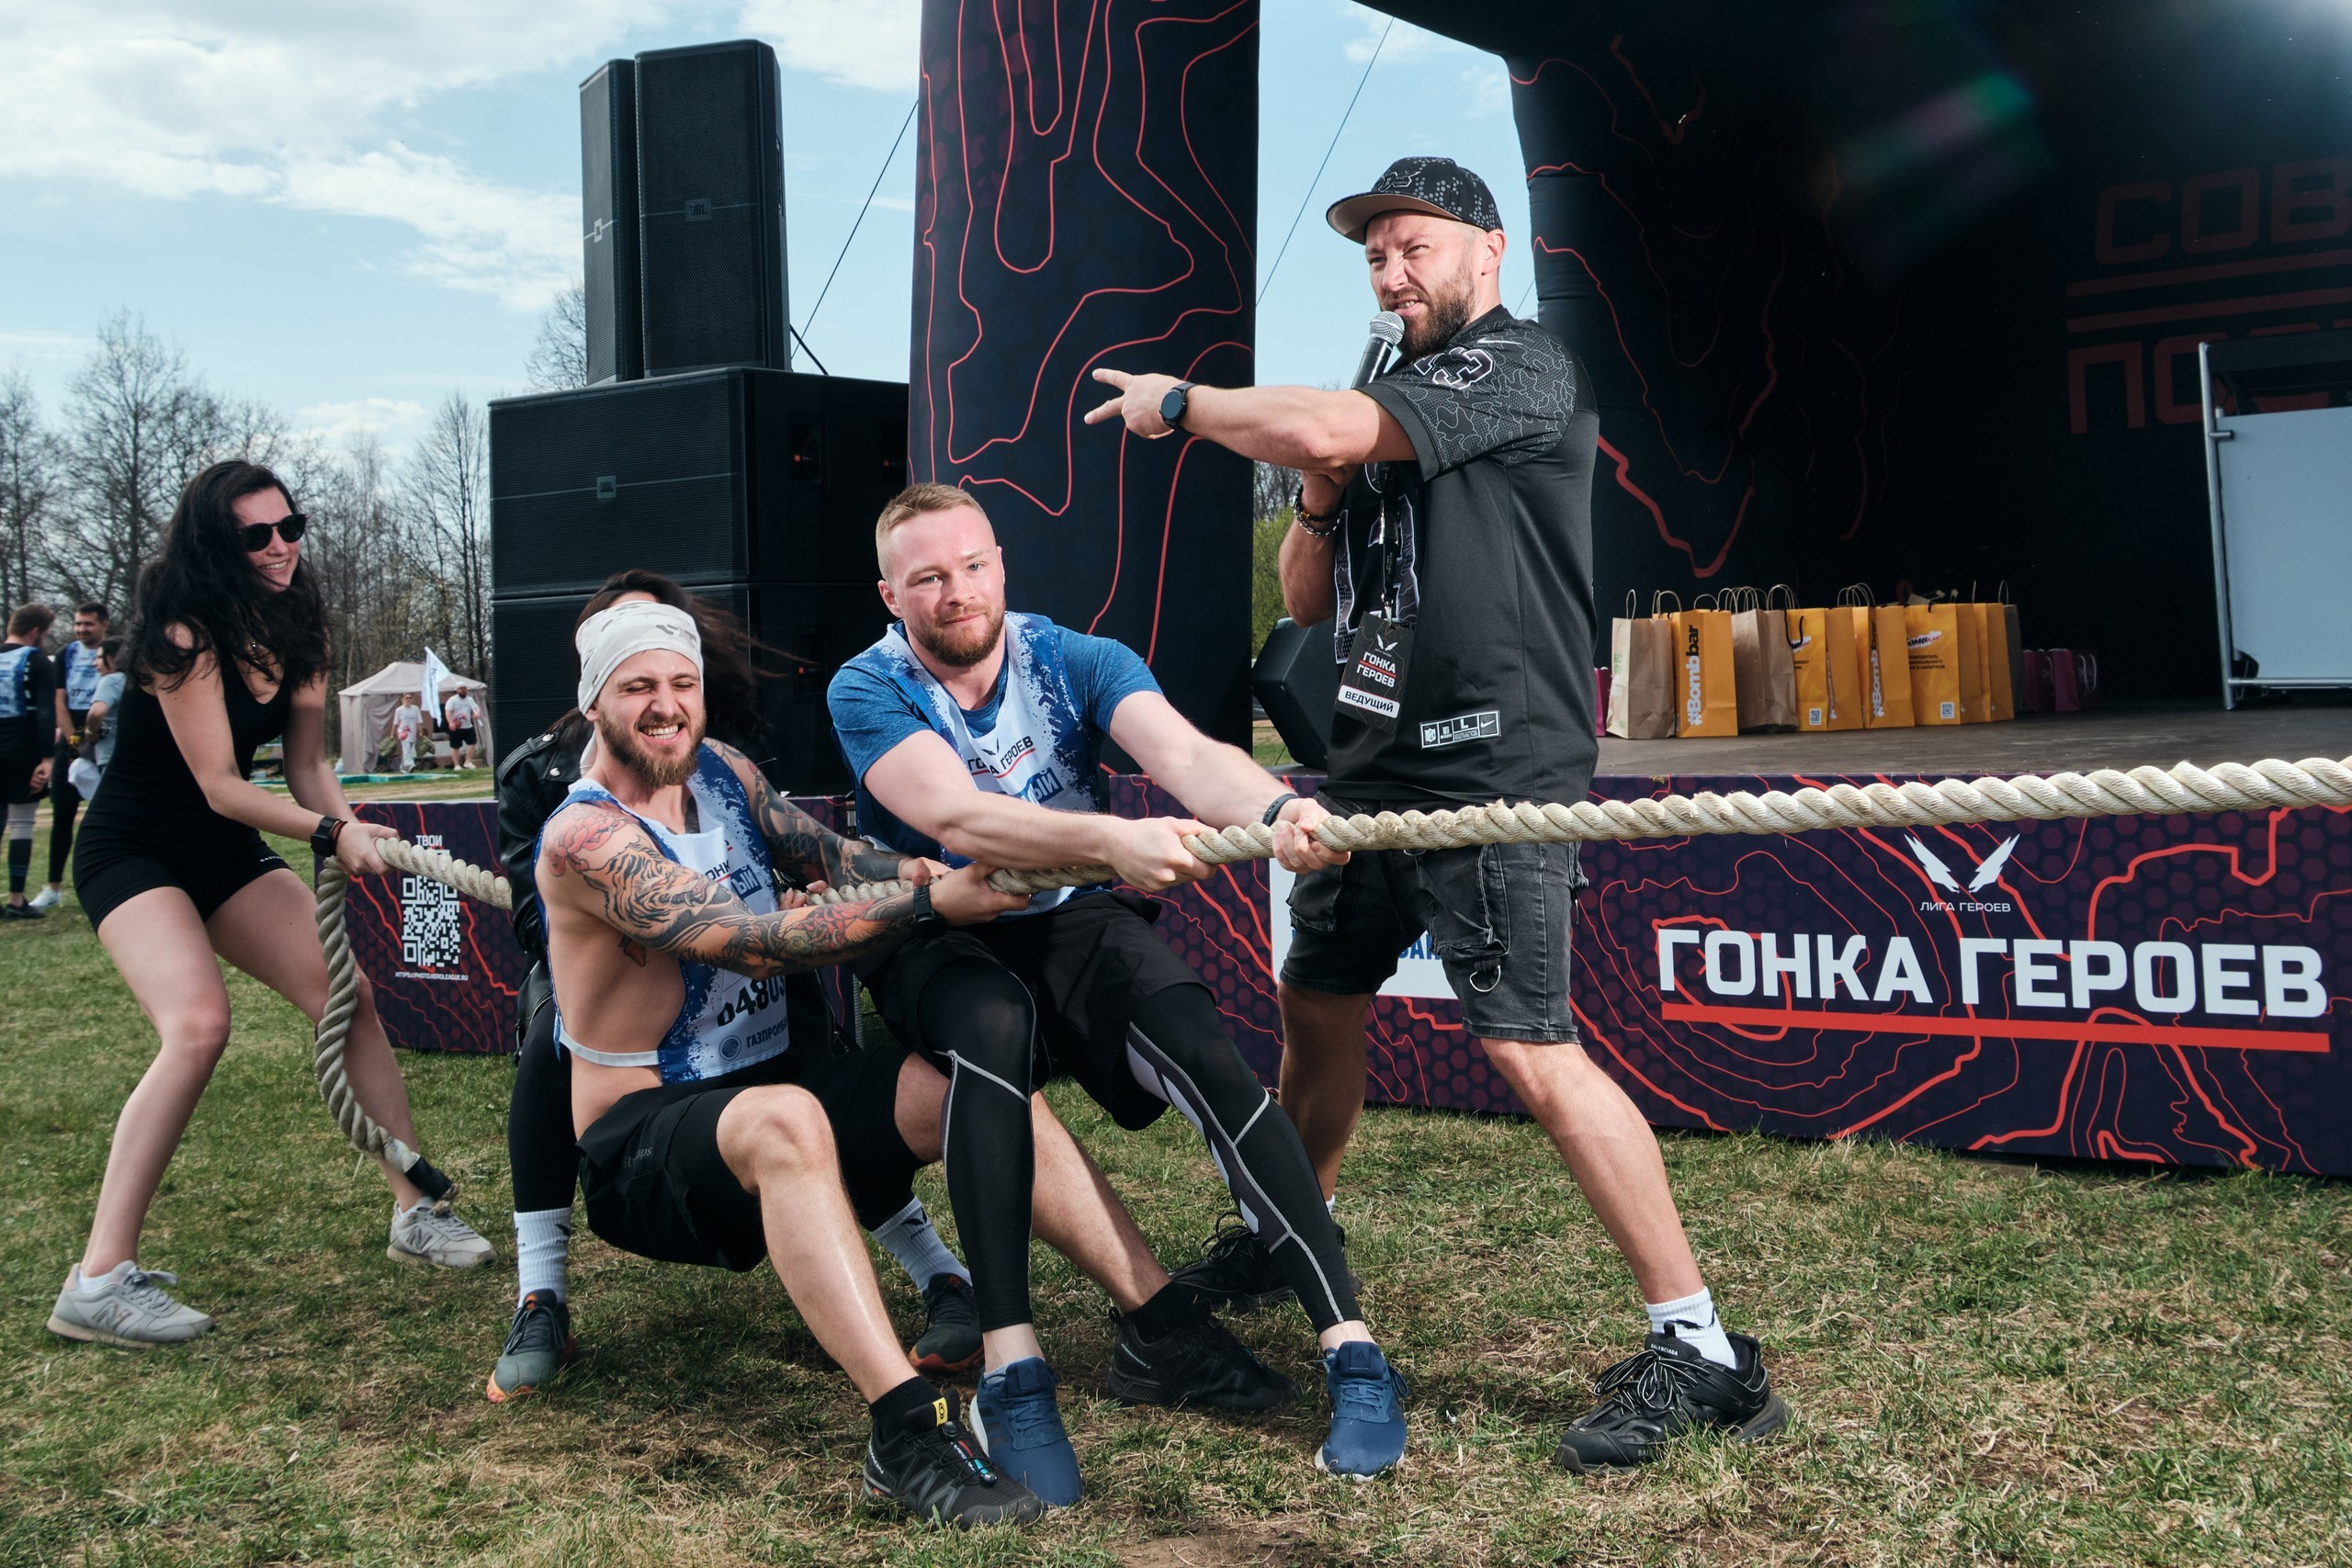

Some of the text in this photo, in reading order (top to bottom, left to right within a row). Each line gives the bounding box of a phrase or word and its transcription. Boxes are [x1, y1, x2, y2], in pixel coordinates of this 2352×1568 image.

[690, 204, 707, 217] JBL
[1363, 651, 1396, 673] ГОНКА
[1356, 663, 1396, 688] ГЕРОЕВ
[1685, 625, 1702, 726] #Bombbar
[1344, 690, 1395, 713] ВЕДУЩИЙ
[1000, 735, 1035, 771] ГЕРОЕВ
[1919, 901, 2012, 913] ЛИГА ГЕРОЕВ
[1657, 928, 2329, 1019] ГОНКА ГЕРОЕВ
